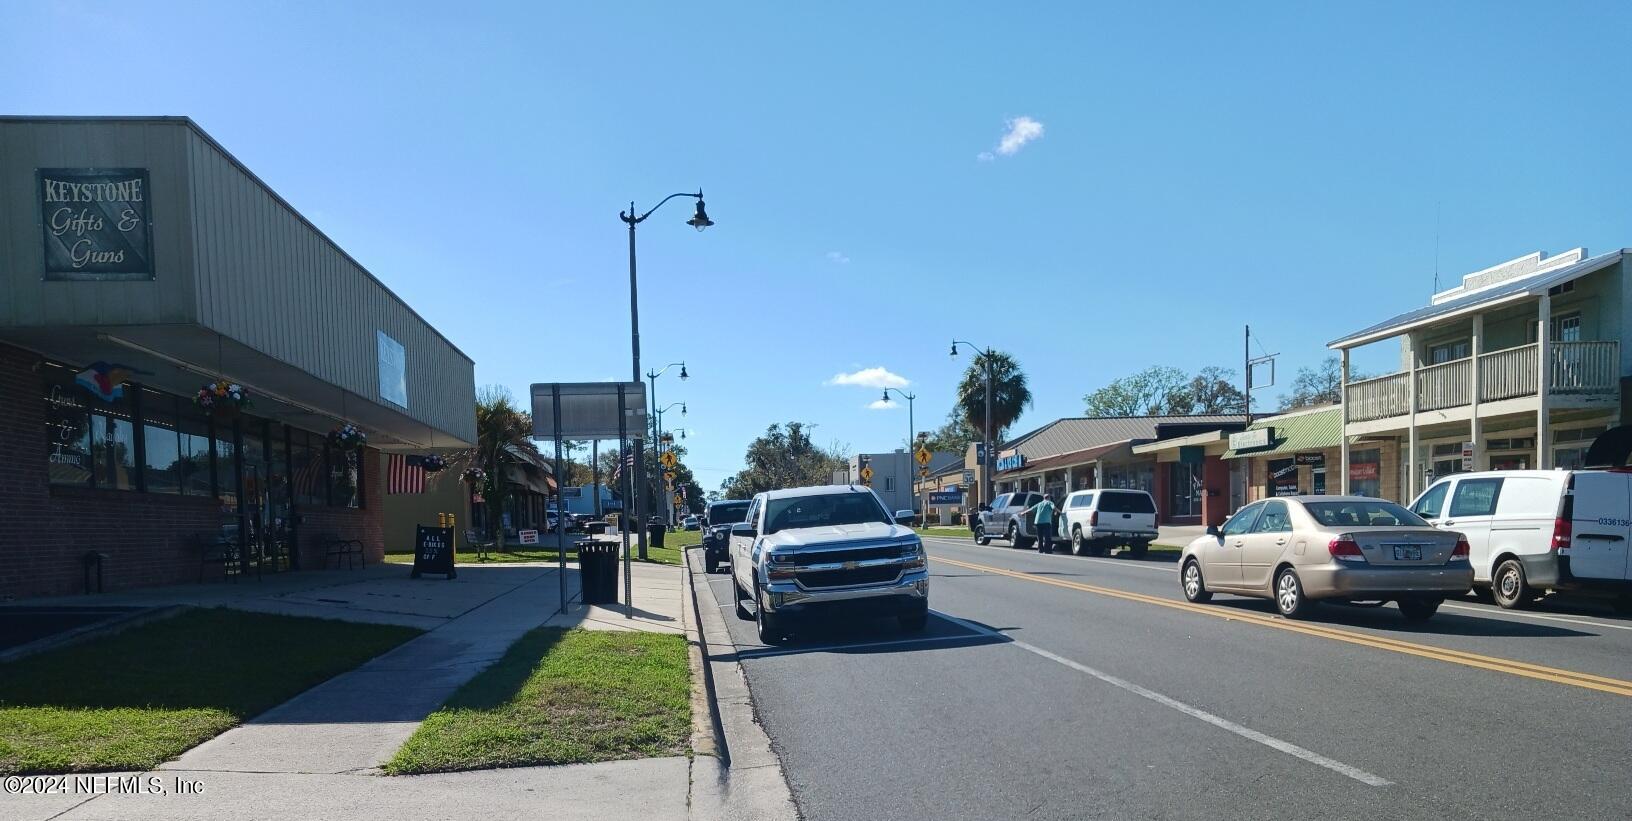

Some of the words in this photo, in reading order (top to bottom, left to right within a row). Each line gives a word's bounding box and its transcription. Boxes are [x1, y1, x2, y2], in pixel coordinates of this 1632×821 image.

[44, 178, 143, 202] KEYSTONE
[51, 207, 103, 236] Gifts
[118, 209, 140, 231] &
[71, 239, 124, 268] Guns
